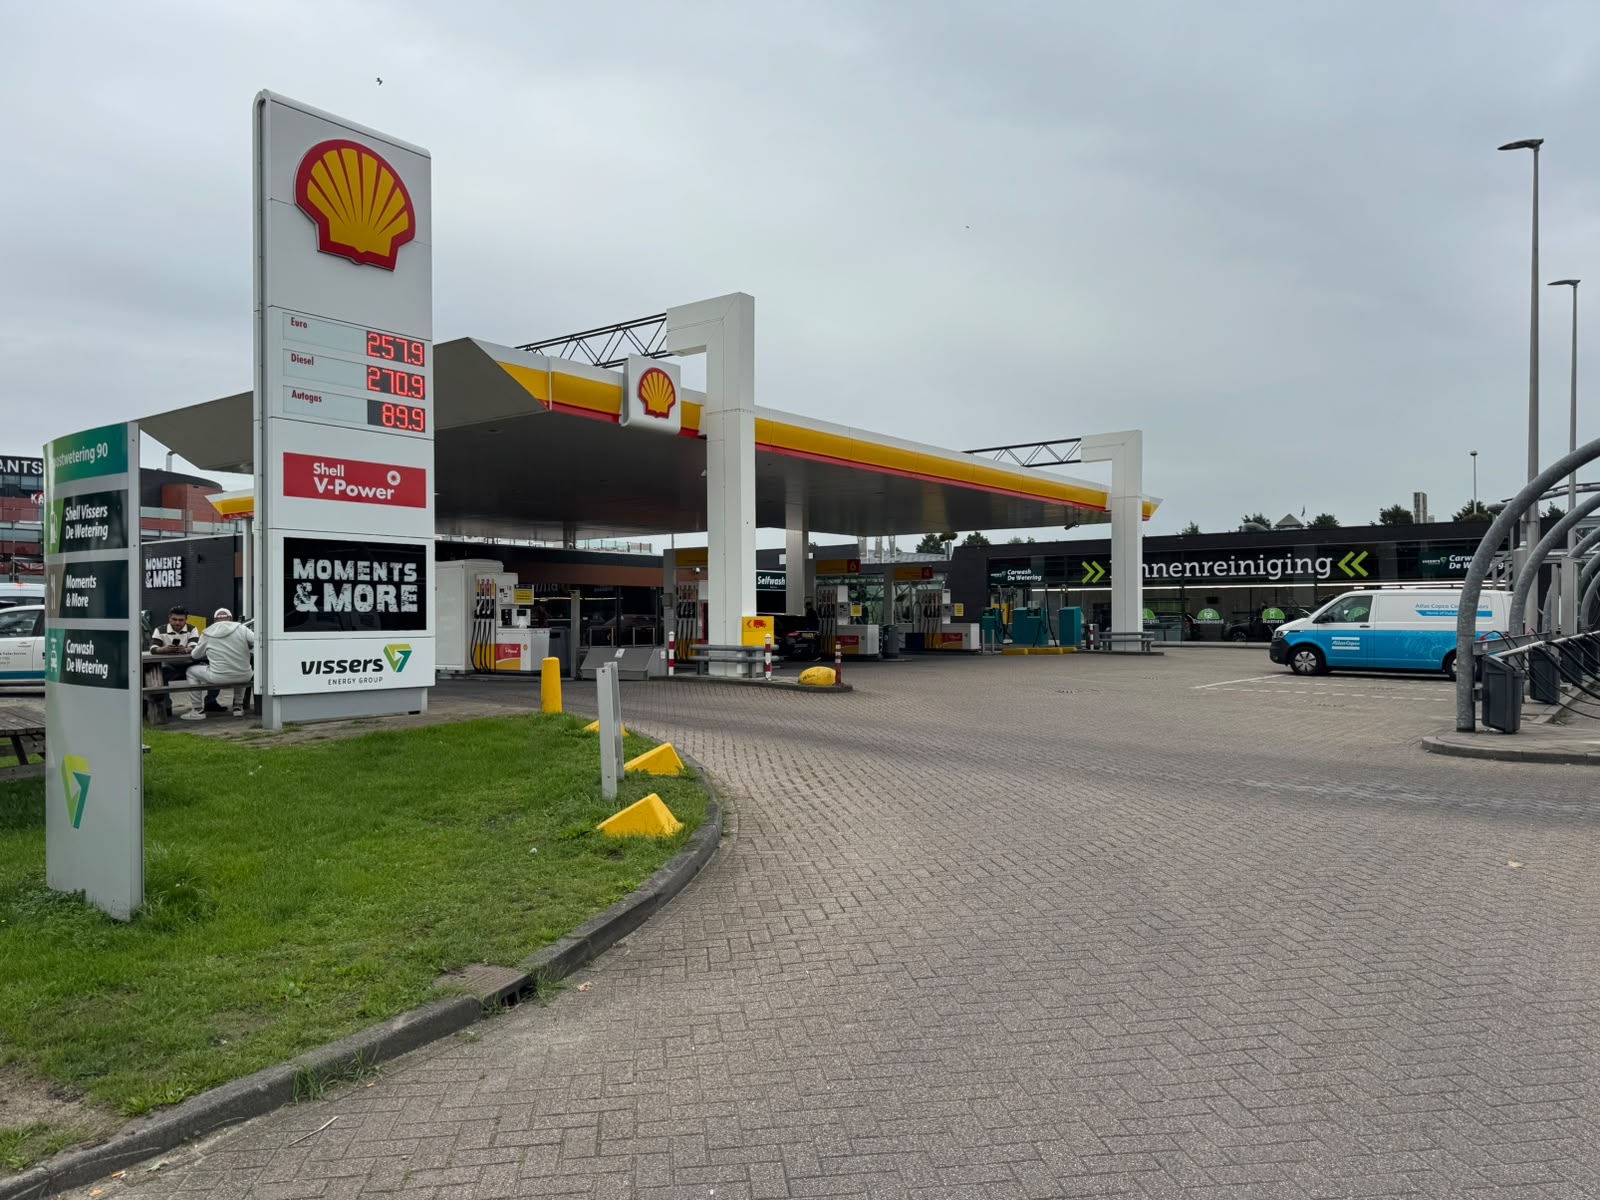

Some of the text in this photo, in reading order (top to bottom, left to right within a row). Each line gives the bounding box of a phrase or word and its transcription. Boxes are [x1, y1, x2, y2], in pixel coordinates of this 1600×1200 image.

[290, 317, 308, 329] Euro
[367, 332, 424, 366] 257.9
[290, 353, 315, 366] Diesel
[367, 367, 424, 399] 270.9
[291, 389, 322, 403] Autogas
[381, 403, 424, 431] 89.9
[97, 442, 108, 458] 90
[313, 462, 345, 477] Shell
[313, 476, 394, 500] V-Power
[65, 504, 108, 521] Shell Vissers
[65, 522, 108, 541] De Wetering
[145, 556, 182, 571] MOMENTS
[1449, 554, 1474, 562] Carw
[1449, 562, 1462, 570] De
[293, 558, 418, 582] MOMENTS
[1016, 574, 1042, 582] Wetering
[65, 574, 97, 590] Moments
[153, 570, 182, 588] MORE
[757, 575, 786, 586] Selfwash
[65, 594, 89, 608] & More
[293, 582, 418, 613] & MORE
[1431, 603, 1450, 611] Copco
[65, 639, 94, 655] Carwash
[65, 659, 108, 679] De Wetering
[301, 658, 384, 676] vissers
[327, 676, 384, 686] ENERGY GROUP
